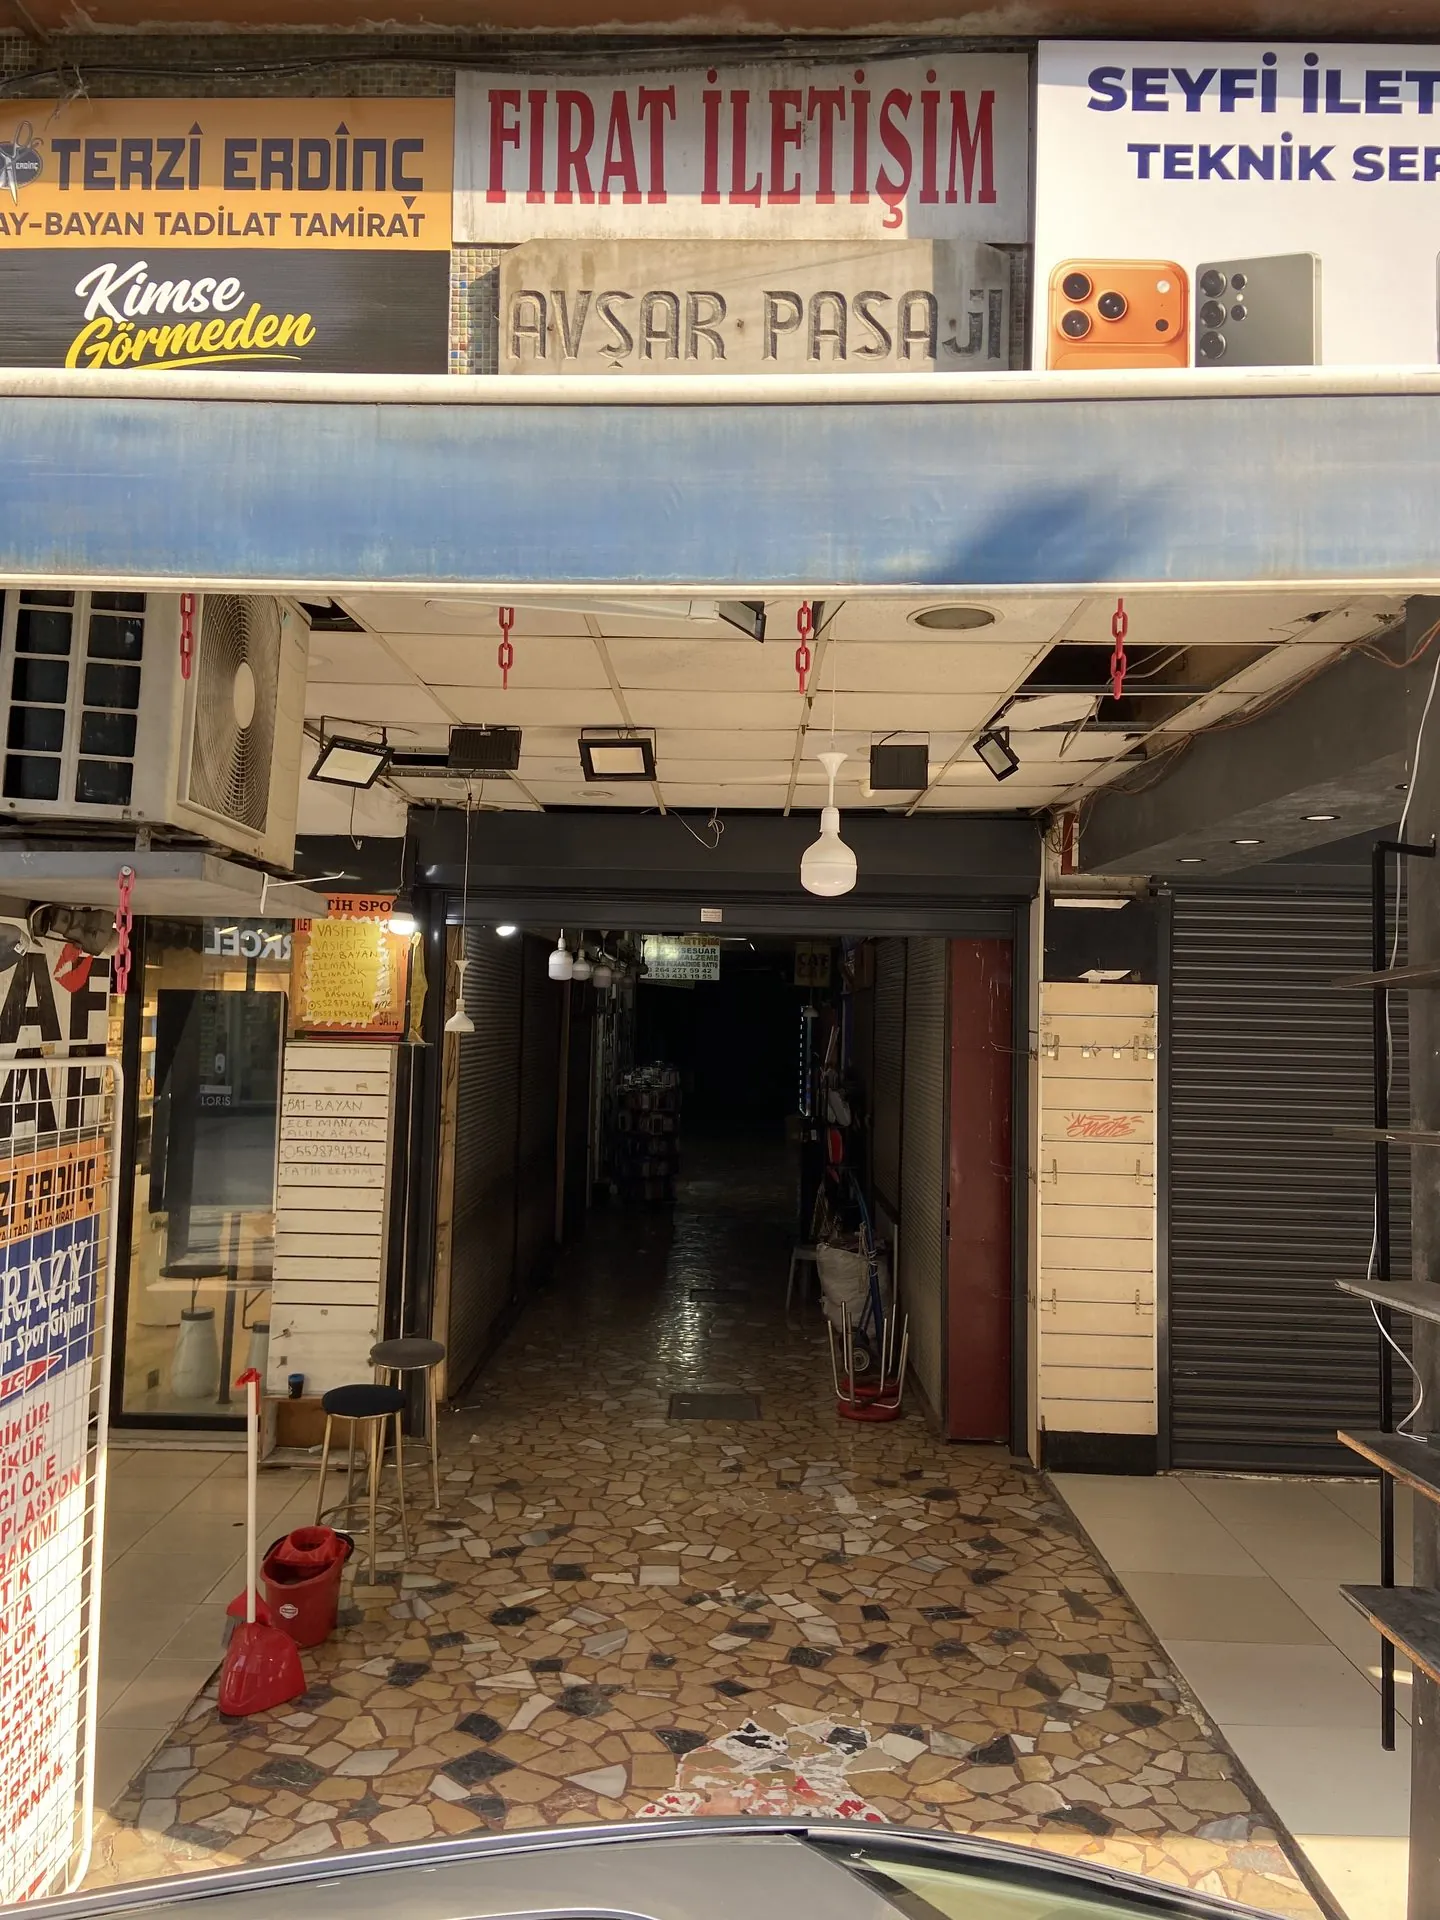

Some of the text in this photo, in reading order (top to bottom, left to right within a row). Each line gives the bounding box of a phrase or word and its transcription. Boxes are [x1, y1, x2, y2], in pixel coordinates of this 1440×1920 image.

[1087, 51, 1440, 114] SEYFİ İLET
[51, 121, 424, 210] TERZİ ERDİNÇ
[485, 68, 997, 229] FIRAT İLETİŞİM
[1127, 131, 1337, 181] TEKNİK
[154, 205, 282, 237] TADİLAT
[290, 206, 426, 237] TAMİRAT
[75, 260, 245, 324] Kimse
[64, 302, 316, 369] Görmeden
[507, 289, 728, 369] AVŞAR
